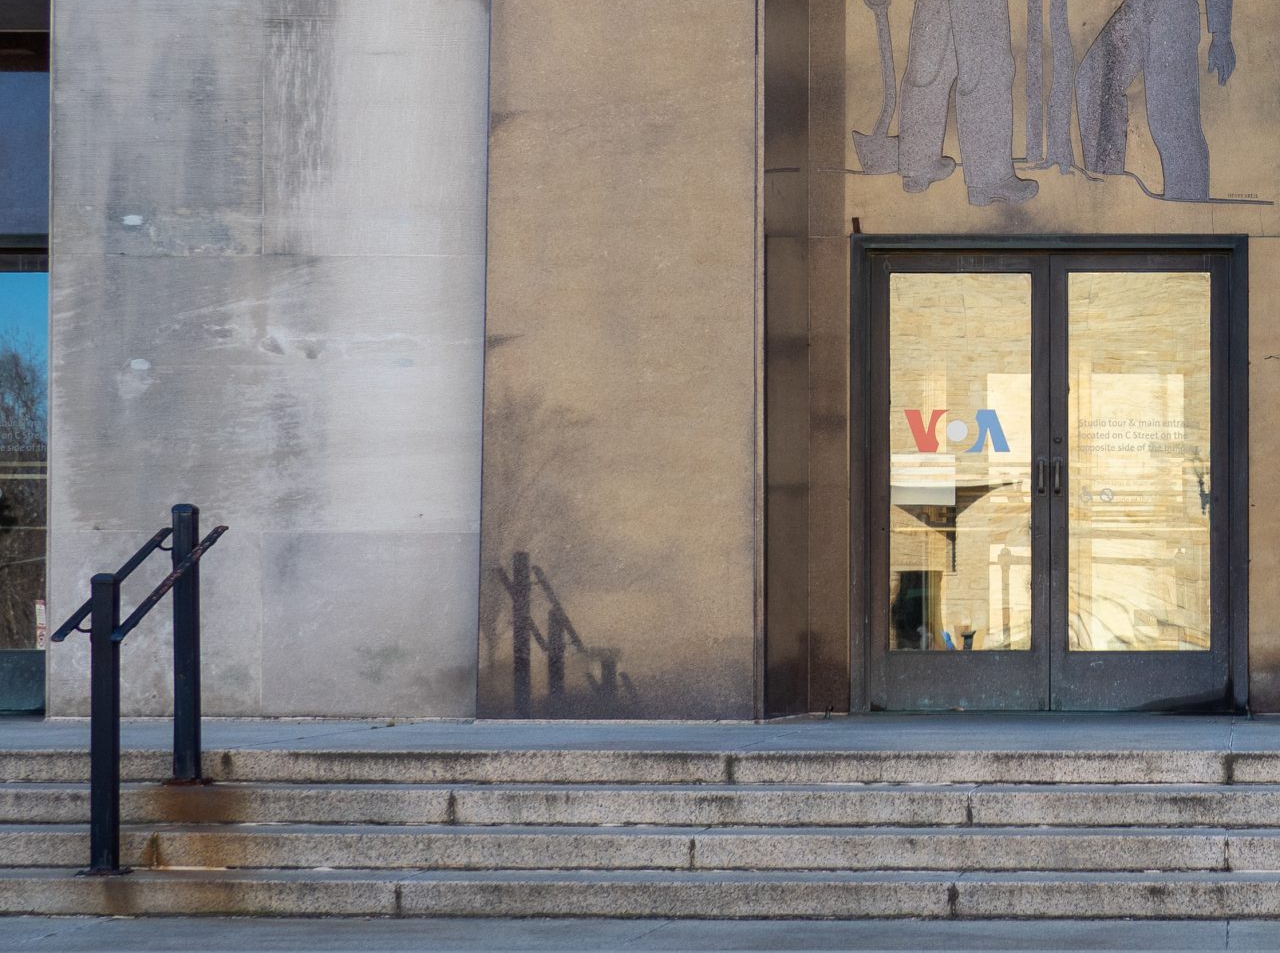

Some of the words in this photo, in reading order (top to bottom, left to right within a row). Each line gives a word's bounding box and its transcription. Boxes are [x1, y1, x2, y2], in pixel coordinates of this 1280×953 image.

[1079, 418, 1107, 428] Studio
[1108, 419, 1126, 427] tour
[1128, 418, 1136, 427] &
[1138, 418, 1161, 427] main
[903, 409, 1011, 453] VOA
[1079, 430, 1110, 440] located
[1111, 432, 1123, 440] on
[1125, 431, 1132, 440] C
[1133, 430, 1159, 440] Street
[1160, 432, 1172, 440] on
[1173, 430, 1188, 440] the
[1117, 442, 1136, 452] side
[1137, 442, 1147, 452] of
